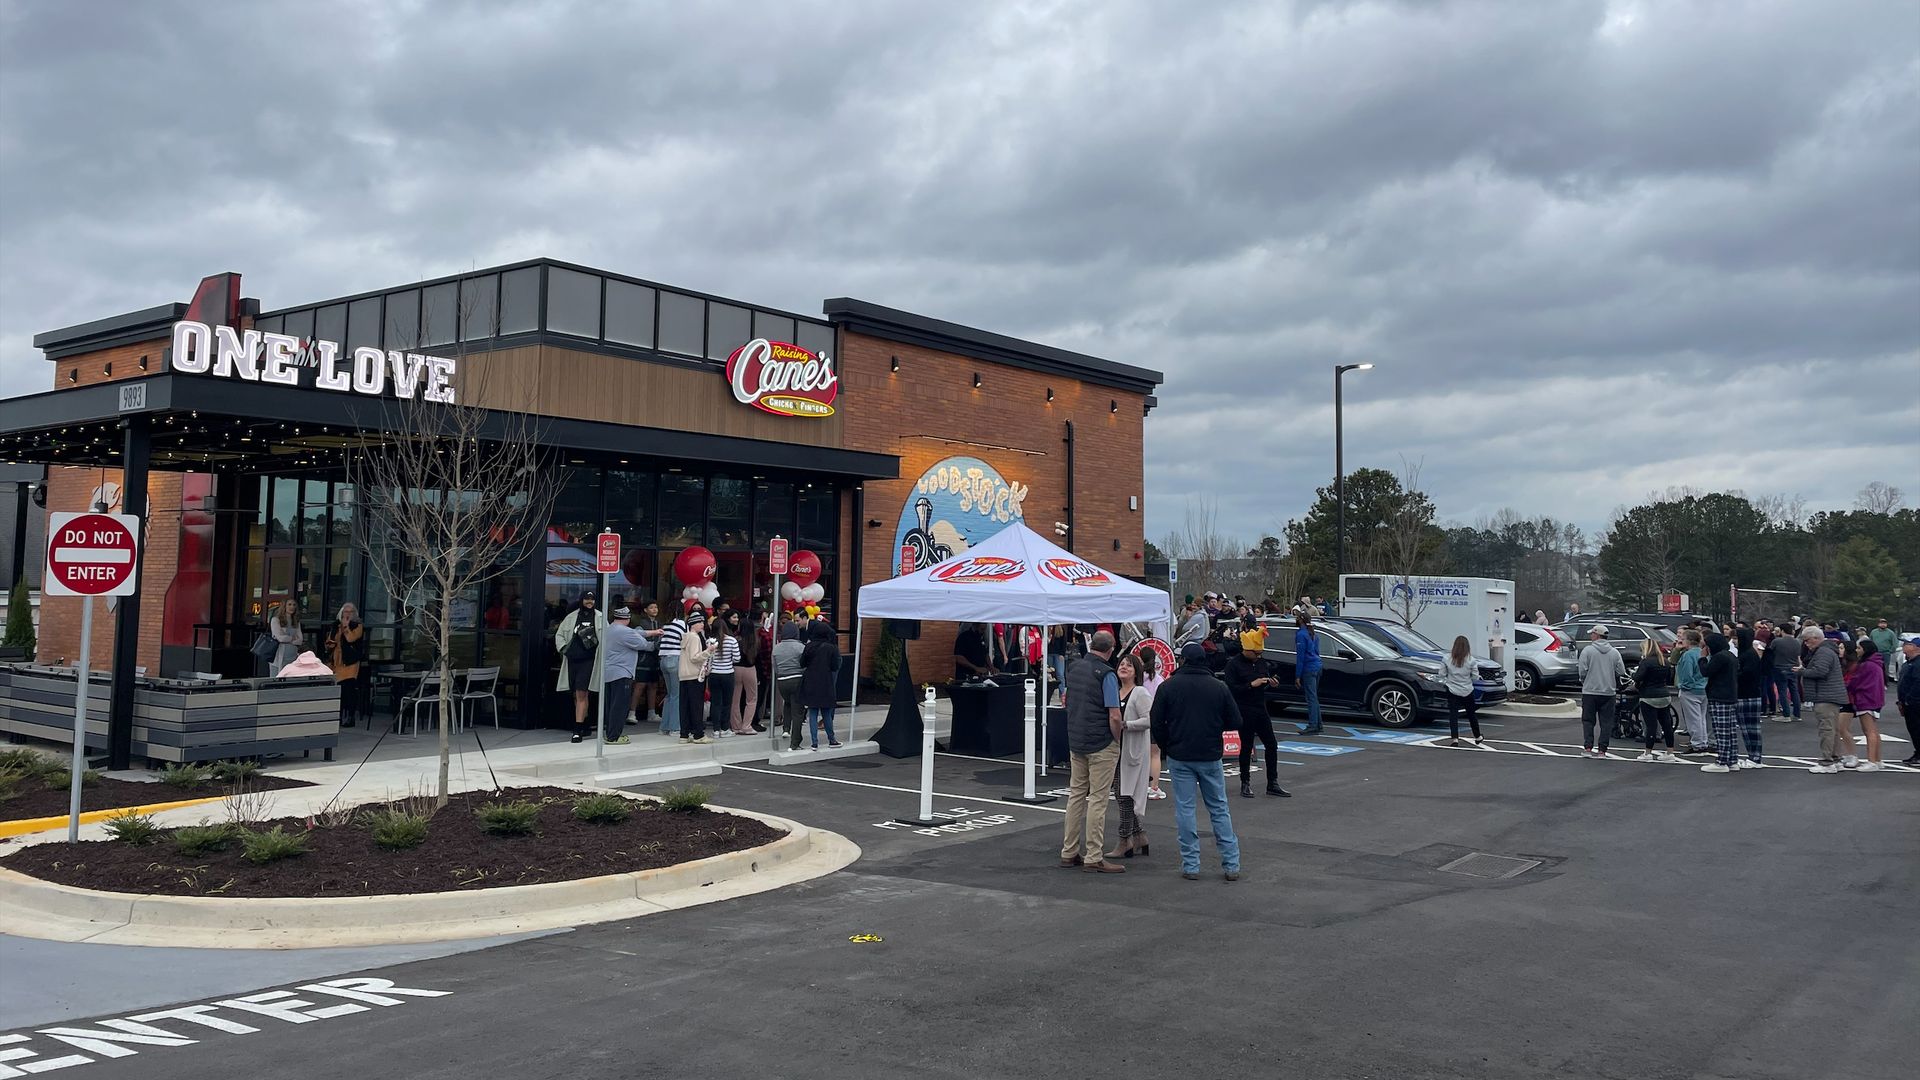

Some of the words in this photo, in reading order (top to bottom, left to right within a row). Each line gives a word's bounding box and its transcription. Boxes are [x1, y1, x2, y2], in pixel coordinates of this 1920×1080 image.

[172, 320, 300, 385] ONE
[316, 339, 457, 403] LOVE
[771, 345, 809, 364] Raising
[732, 338, 838, 404] Cane's
[123, 385, 142, 409] 9893
[917, 466, 1029, 523] WOODSTOCK
[65, 529, 87, 546] DO
[93, 529, 123, 546] NOT
[67, 565, 117, 581] ENTER
[927, 557, 1028, 583] Cane's
[1038, 558, 1101, 586] Cane's
[1418, 588, 1469, 596] RENTAL
[912, 813, 1017, 837] PICKUP
